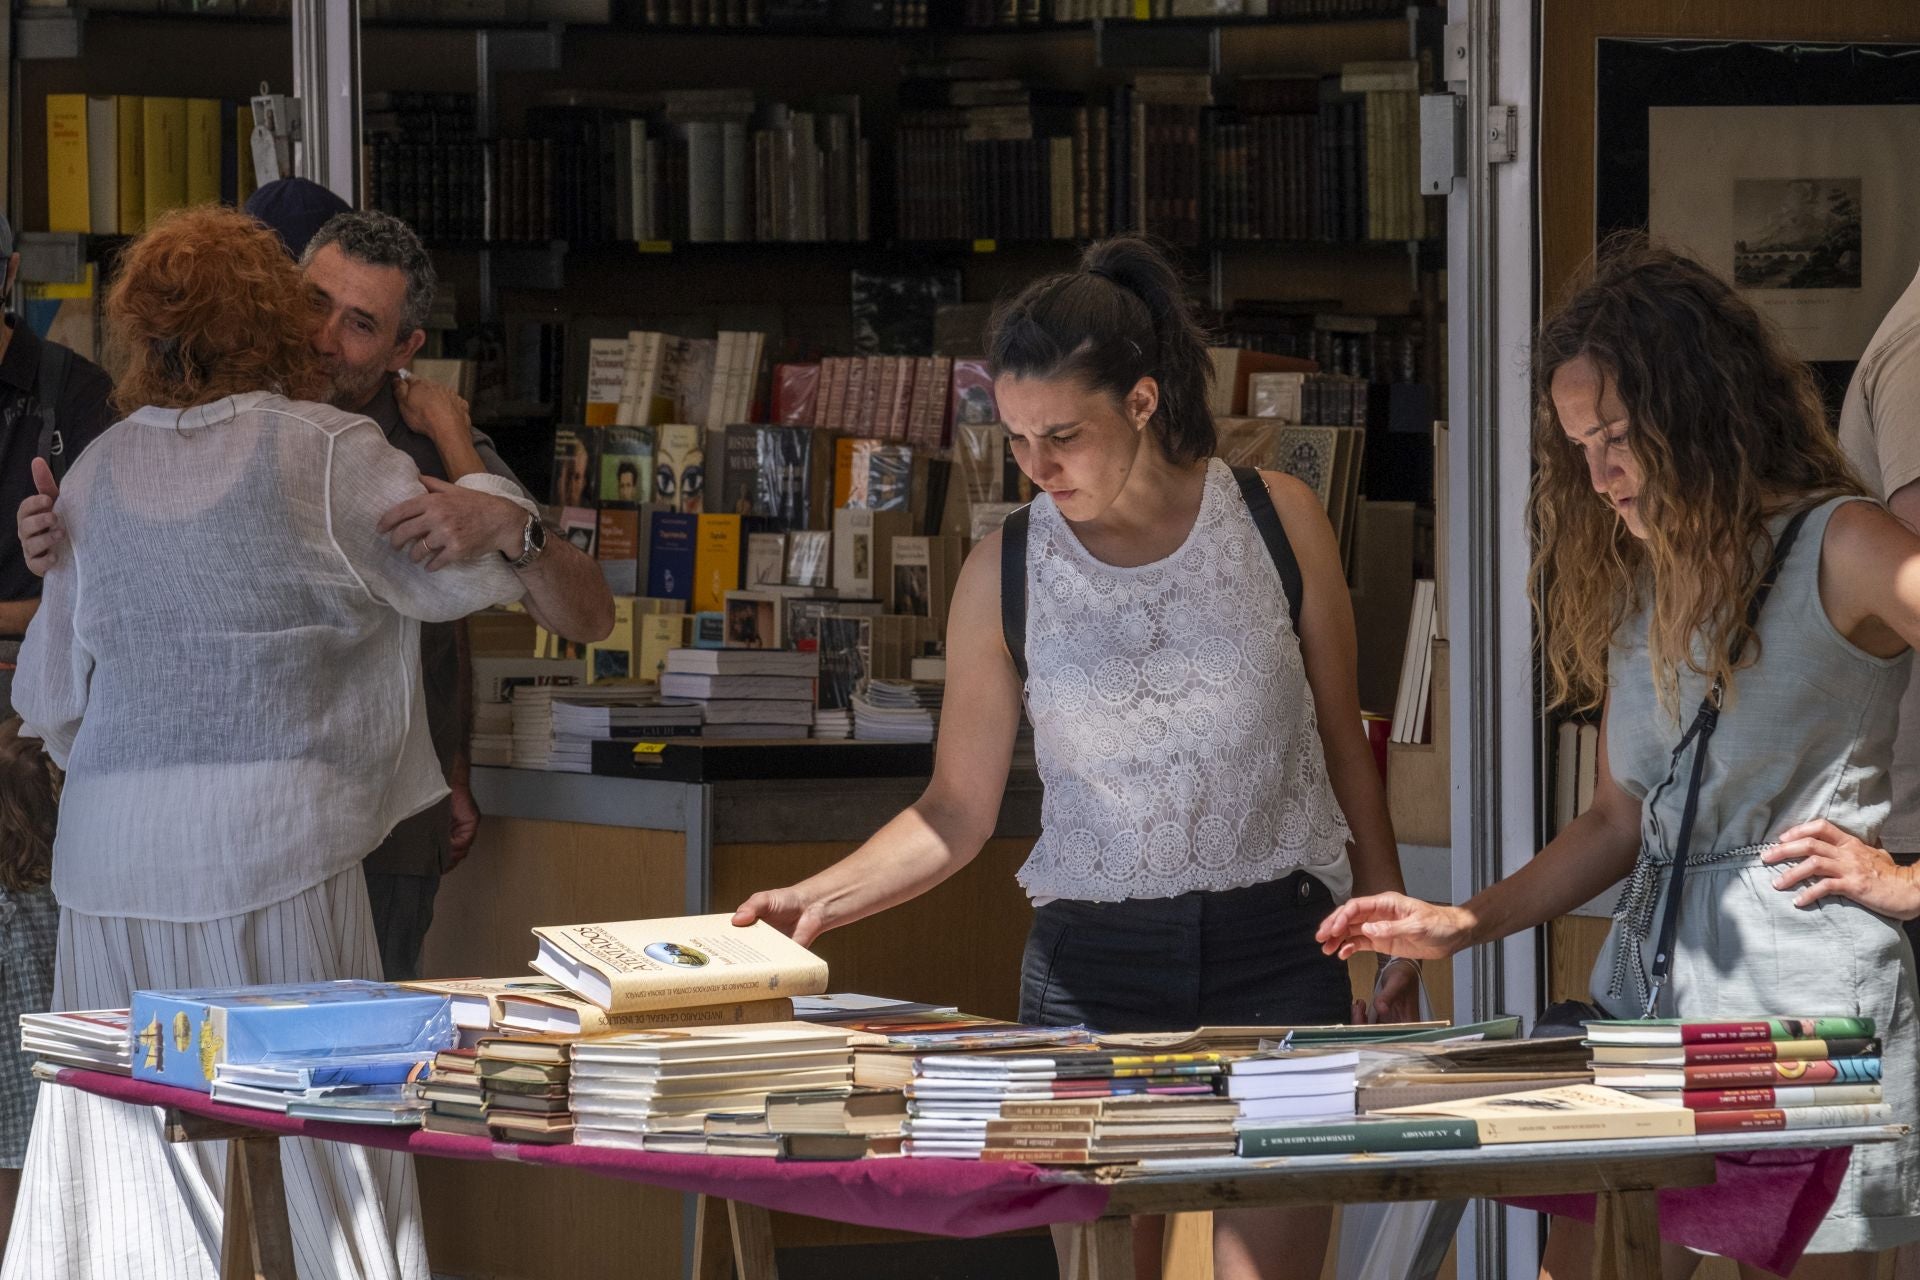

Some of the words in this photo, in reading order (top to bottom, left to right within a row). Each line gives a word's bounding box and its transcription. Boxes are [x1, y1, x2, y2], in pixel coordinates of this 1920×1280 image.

[573, 927, 653, 972] ATENTADOS
[692, 984, 720, 993] ATENTADOS
[720, 983, 728, 991] DE
[728, 981, 760, 991] DICCIONARIO
[598, 1016, 633, 1026] INSULTOS
[634, 1015, 645, 1024] DE
[646, 1013, 679, 1023] GENERAL
[681, 1011, 723, 1022] INVENTARIO
